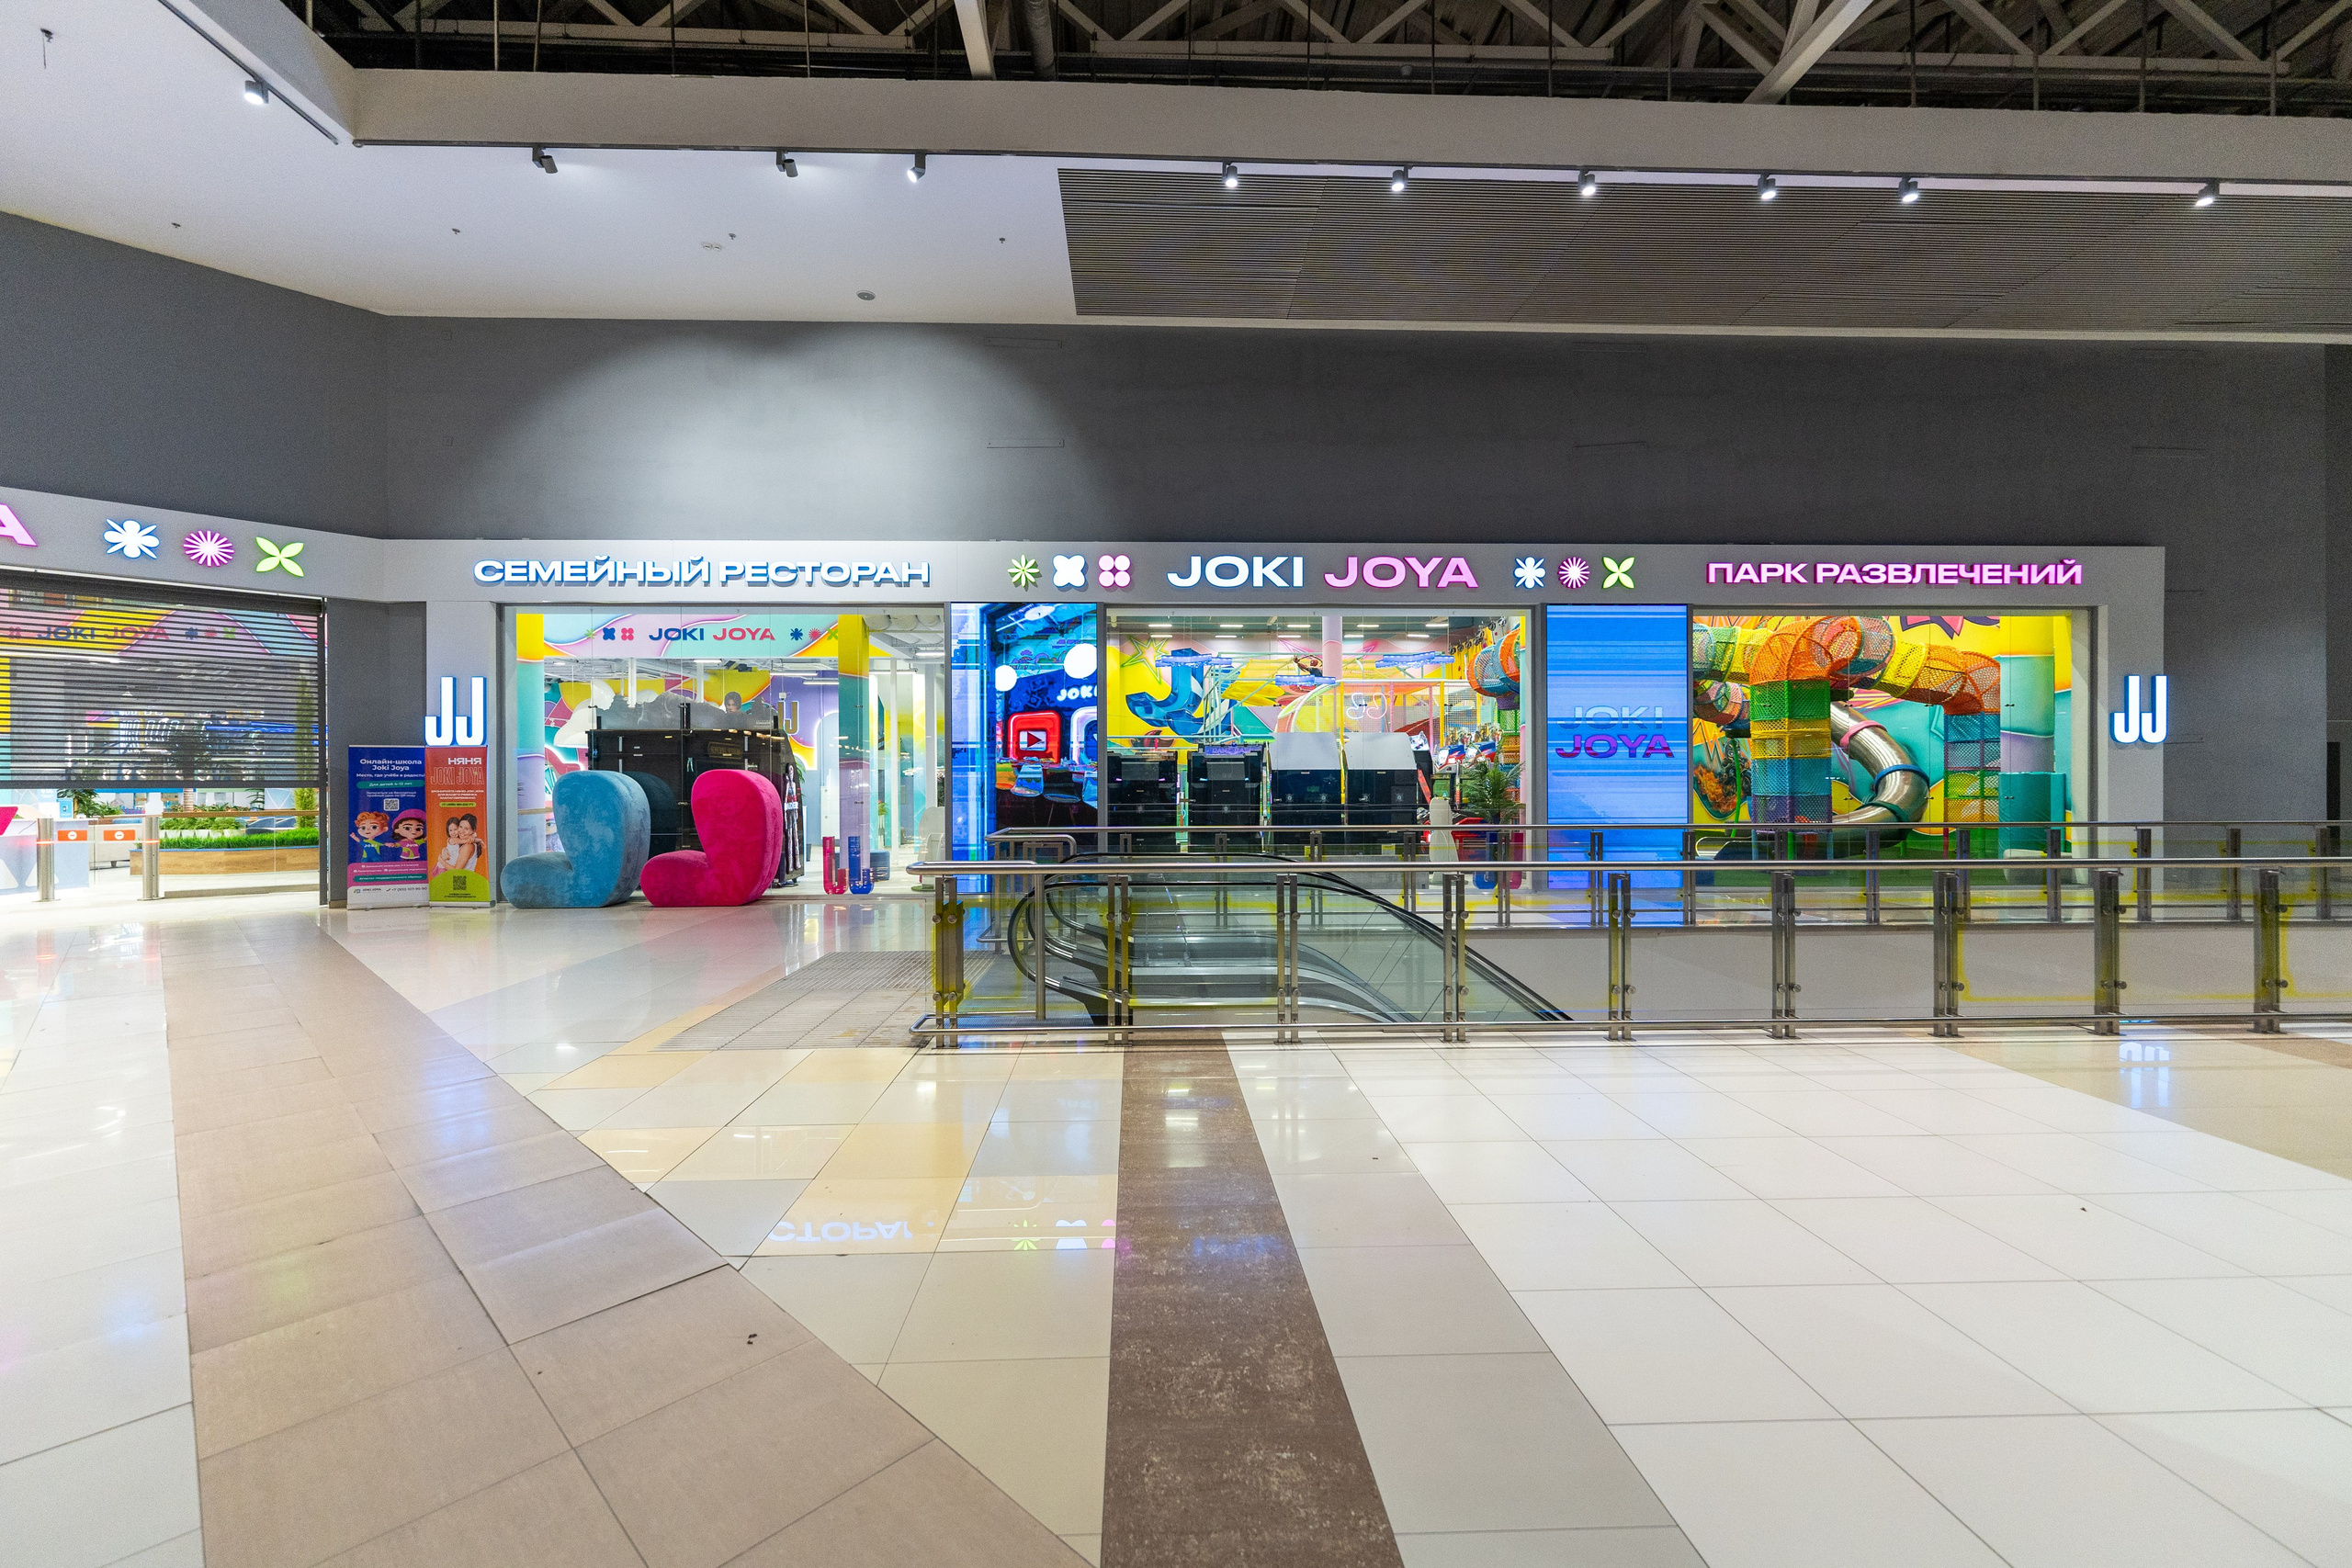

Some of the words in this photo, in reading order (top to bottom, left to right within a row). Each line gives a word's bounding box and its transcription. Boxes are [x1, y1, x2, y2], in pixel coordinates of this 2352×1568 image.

[473, 555, 710, 585] СЕМЕЙНЫЙ
[718, 560, 930, 585] РЕСТОРАН
[1167, 555, 1305, 588] JOKI
[1323, 556, 1479, 589] JOYA
[1706, 562, 1808, 584] ПАРК
[1813, 558, 2083, 585] РАЗВЛЕЧЕНИЙ
[38, 626, 96, 640] JOKI
[104, 626, 170, 640] JOYA
[649, 627, 705, 641] JOKI
[712, 627, 775, 641] JOYA
[424, 675, 488, 746] JJ
[1556, 705, 1664, 730] JOKI
[2109, 673, 2169, 745] JJ
[1555, 733, 1675, 759] JOYA
[447, 757, 482, 765] НЯНЯ
[430, 766, 456, 785] JOKI
[456, 766, 485, 785] JOYA
